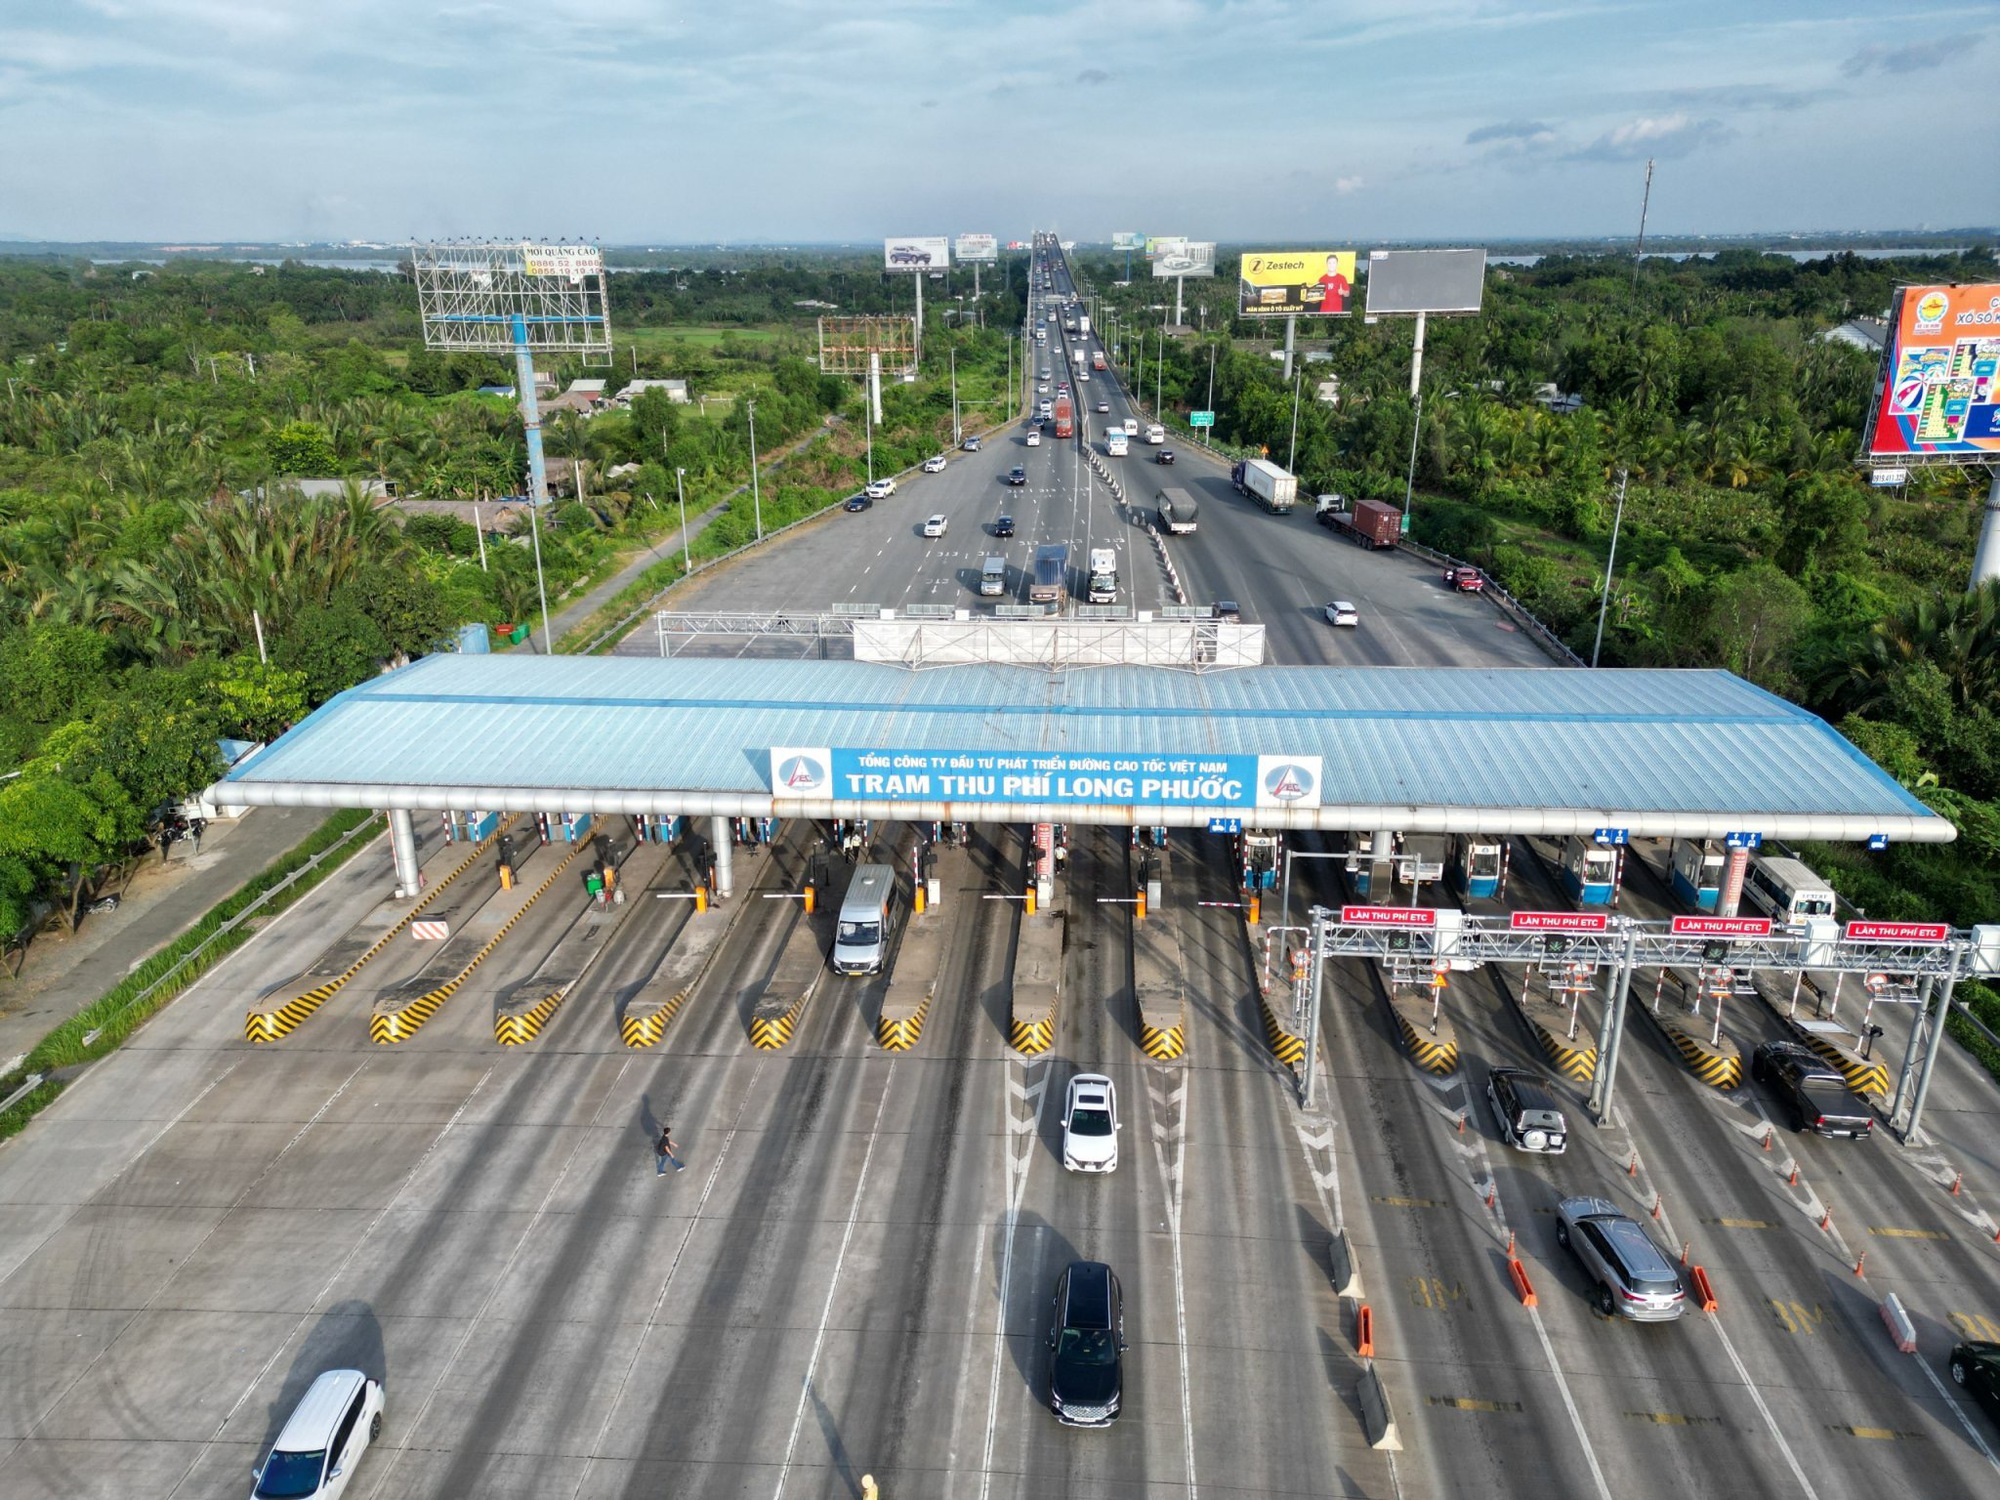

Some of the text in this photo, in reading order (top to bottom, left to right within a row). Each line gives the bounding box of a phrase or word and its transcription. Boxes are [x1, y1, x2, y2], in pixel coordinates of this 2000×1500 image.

[1266, 261, 1305, 270] Zestech
[859, 752, 1228, 774] TỔNG CÔNG TY ĐẦU TƯ PHÁT TRIỂN ĐƯỜNG CAO TỐC VIỆT NAM
[846, 772, 1242, 800] TRẠM THU PHÍ LONG PHƯỚC
[1350, 910, 1428, 922] LÀN THU PHÍ ETC
[1520, 916, 1598, 927] LÀN THU PHÍ ETC
[1680, 920, 1762, 932] LÀN THU PHÍ ETC
[1855, 926, 1938, 938] LÀN THU PHÍ ETC
